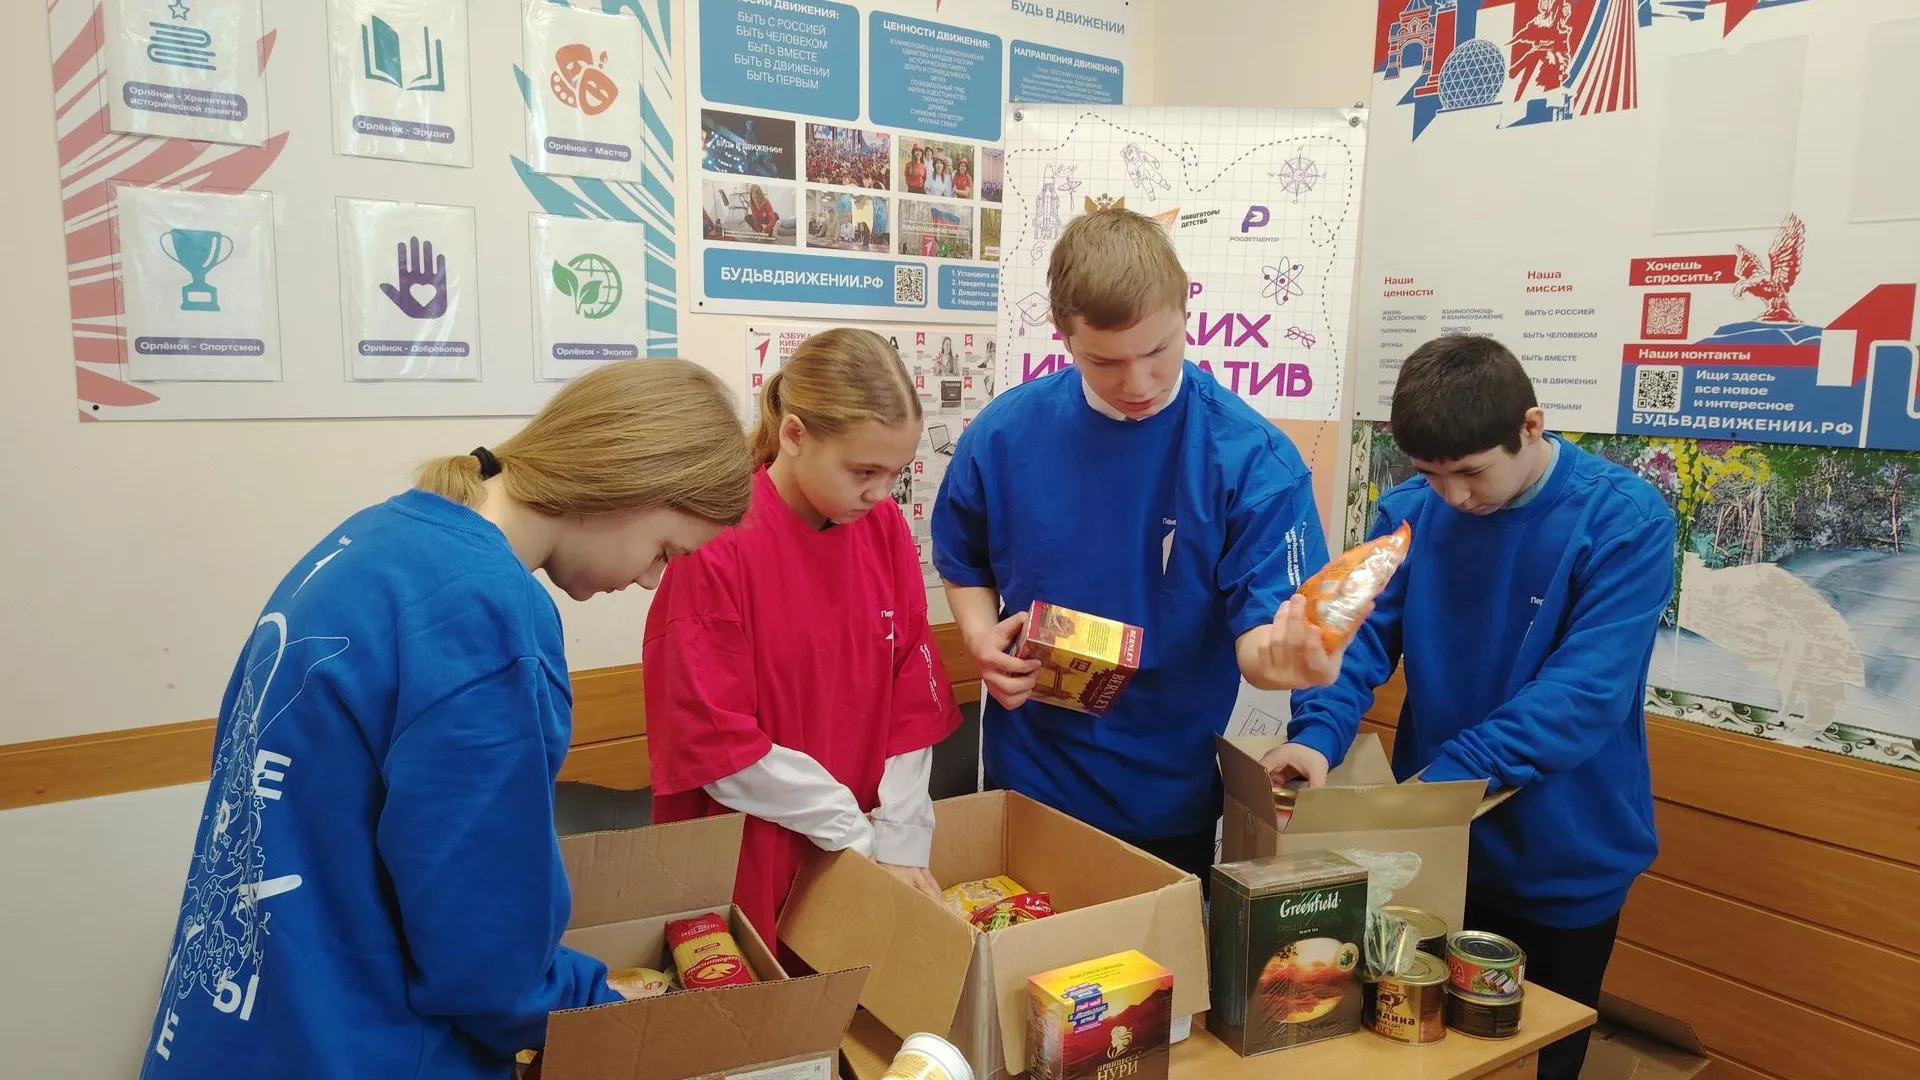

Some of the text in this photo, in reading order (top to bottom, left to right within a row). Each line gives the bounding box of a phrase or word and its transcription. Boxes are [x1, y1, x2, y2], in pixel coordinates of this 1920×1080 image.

[774, 0, 840, 20] ДВИЖЕНИЯ:
[1011, 0, 1125, 34] БУДЬ В ДВИЖЕНИИ
[737, 11, 826, 36] БЫТЬ С РОССИЕЙ
[736, 25, 828, 50] БЫТЬ ЧЕЛОВЕКОМ
[883, 20, 991, 49] ЦЕННОСТИ ДВИЖЕНИЯ:
[747, 41, 818, 62] БЫТЬ ВМЕСТЕ
[734, 54, 830, 78] БЫТЬ В ДВИЖЕНИИ
[1014, 47, 1121, 75] НАПРАВЛЕНИЯ ДВИЖЕНИЯ:
[747, 69, 819, 90] БЫТЬ ПЕРВЫМ
[129, 86, 238, 107] Орлёнок Хранитель
[130, 97, 241, 117] исторической памяти
[357, 119, 451, 140] Орлёнок Эрудит
[548, 141, 629, 160] Орлёнок Мастер
[742, 143, 783, 154] ДВИЖЕНИИ!
[1181, 209, 1220, 221] НАВИГАТОРЫ
[1181, 218, 1208, 229] ДЕТСТВА
[1645, 260, 1702, 272] Хочешь
[720, 266, 884, 289] БУДЬВДВИЖЕНИИ.РФ
[1384, 276, 1414, 285] Наши
[1527, 270, 1562, 280] Наша
[1645, 271, 1722, 285] спросить?
[1384, 288, 1434, 298] ценности
[1526, 285, 1573, 293] миссия
[1555, 308, 1595, 316] РОССИЕЙ
[780, 332, 811, 340] АЗБУКА
[140, 341, 260, 353] Орлёнок Спортсмен
[362, 343, 465, 354] Орлёнок Доброволец
[556, 347, 632, 357] Орлёнок Эколог
[1638, 349, 1751, 361] Наши контакты
[1696, 370, 1776, 383] Ищи здесь
[1695, 384, 1768, 396] все новое
[1540, 402, 1582, 410] ПЕРВЫМИ
[1694, 399, 1794, 413] и интересное
[1631, 413, 1853, 436] БУДЬВДВИЖЕНИИ.РФ
[1126, 629, 1137, 663] BERNLEY
[1093, 673, 1125, 711] BERNLEY
[1279, 891, 1341, 918] Greenfield
[1097, 1055, 1139, 1071] ПРИНЦЕССА
[1097, 1060, 1139, 1080] НУРИ
